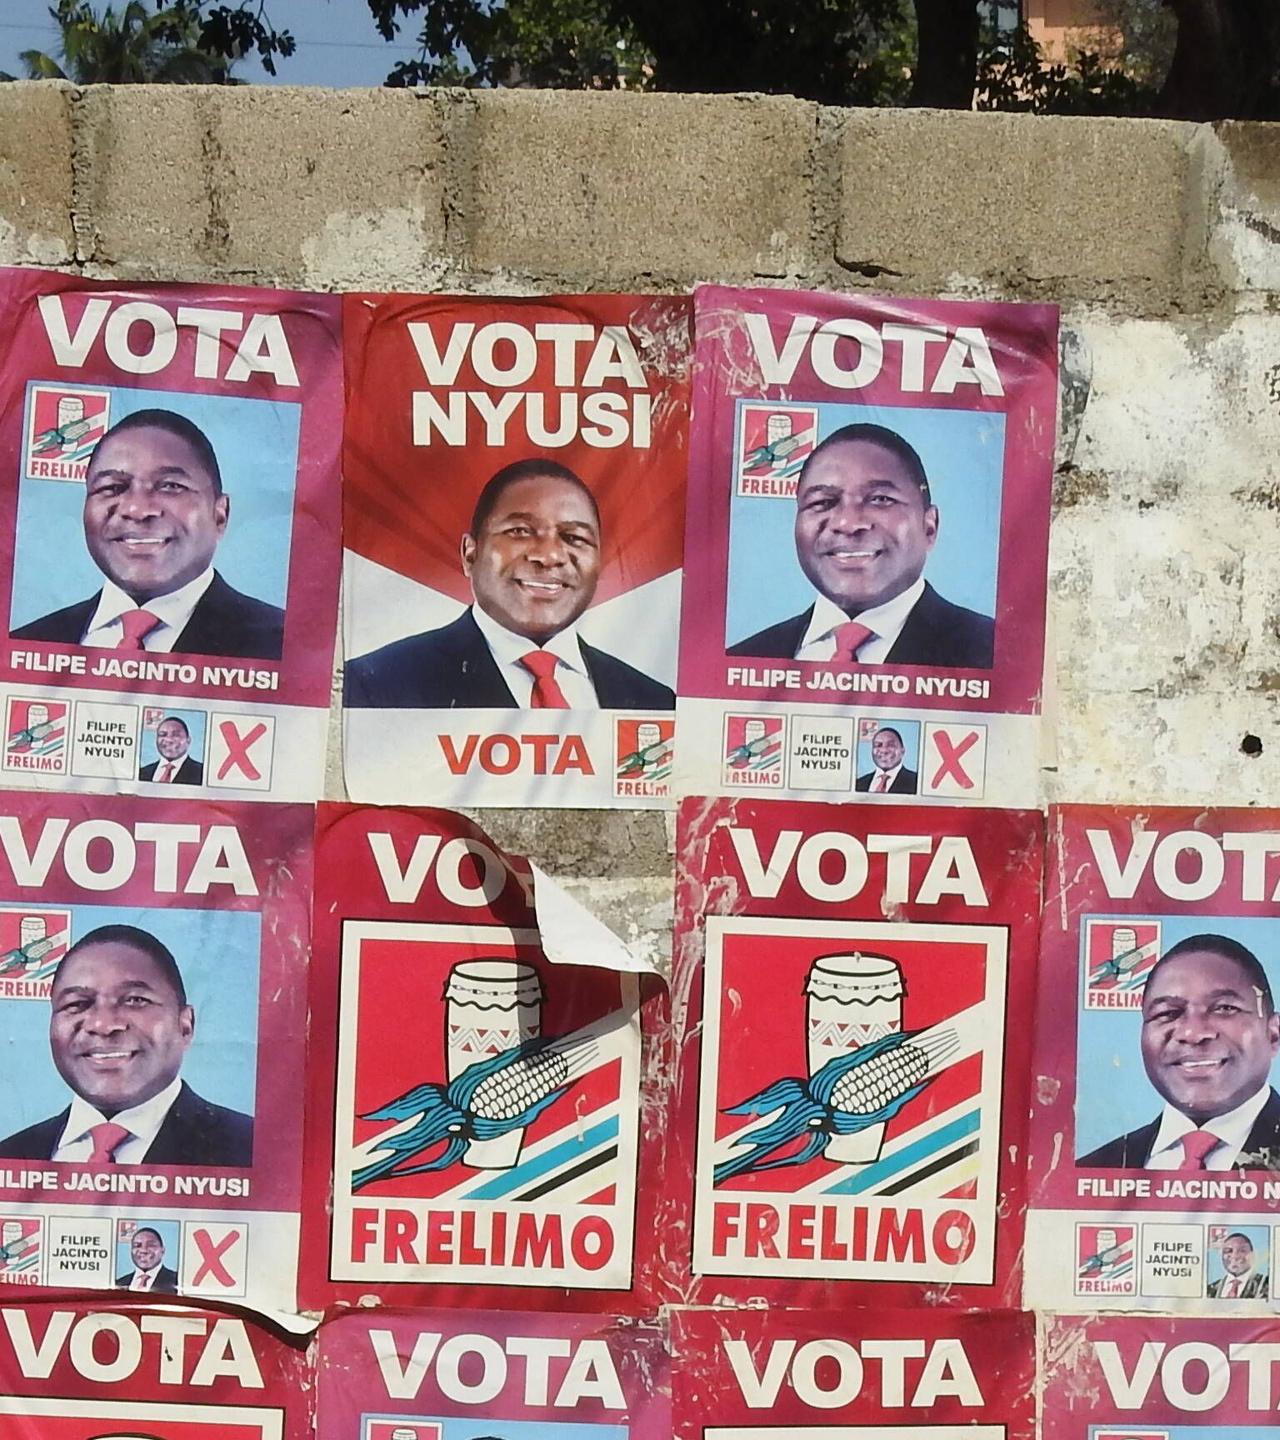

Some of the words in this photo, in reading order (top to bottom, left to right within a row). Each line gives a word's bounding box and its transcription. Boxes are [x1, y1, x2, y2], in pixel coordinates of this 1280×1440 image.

[37, 294, 303, 387] VOTA
[407, 321, 649, 391] VOTA
[742, 311, 1006, 397] VOTA
[412, 391, 651, 449] NYUSI
[10, 651, 86, 675] FILIPE
[91, 655, 197, 680] JACINTO
[203, 666, 279, 690] NYUSI
[727, 669, 802, 688] FILIPE
[806, 672, 910, 695] JACINTO
[915, 678, 990, 699] NYUSI
[87, 721, 127, 735] FILIPE
[77, 734, 134, 747] JACINTO
[802, 734, 842, 747] FILIPE
[6, 755, 64, 771] FRELIMO
[85, 746, 126, 760] NYUSI
[437, 732, 596, 777] VOTA
[794, 746, 850, 759] JACINTO
[801, 757, 841, 771] NYUSI
[729, 827, 989, 907] VOTA
[63, 1172, 168, 1194] JACINTO
[174, 1176, 250, 1197] NYUSI
[1077, 1179, 1150, 1199] FILIPE
[1155, 1180, 1259, 1201] JACINTO
[60, 1234, 101, 1247] FILIPE
[352, 1208, 614, 1272] FRELIMO
[713, 1204, 976, 1266] FRELIMO
[51, 1246, 109, 1259] JACINTO
[1153, 1241, 1193, 1253] FILIPE
[59, 1259, 100, 1272] NYUSI
[1145, 1253, 1200, 1266] JACINTO
[1153, 1266, 1193, 1278] NYUSI
[1078, 1280, 1133, 1294] FRELIMO
[1, 1309, 266, 1389] VOTA
[368, 1330, 628, 1410] VOTA
[723, 1339, 984, 1408] VOTA
